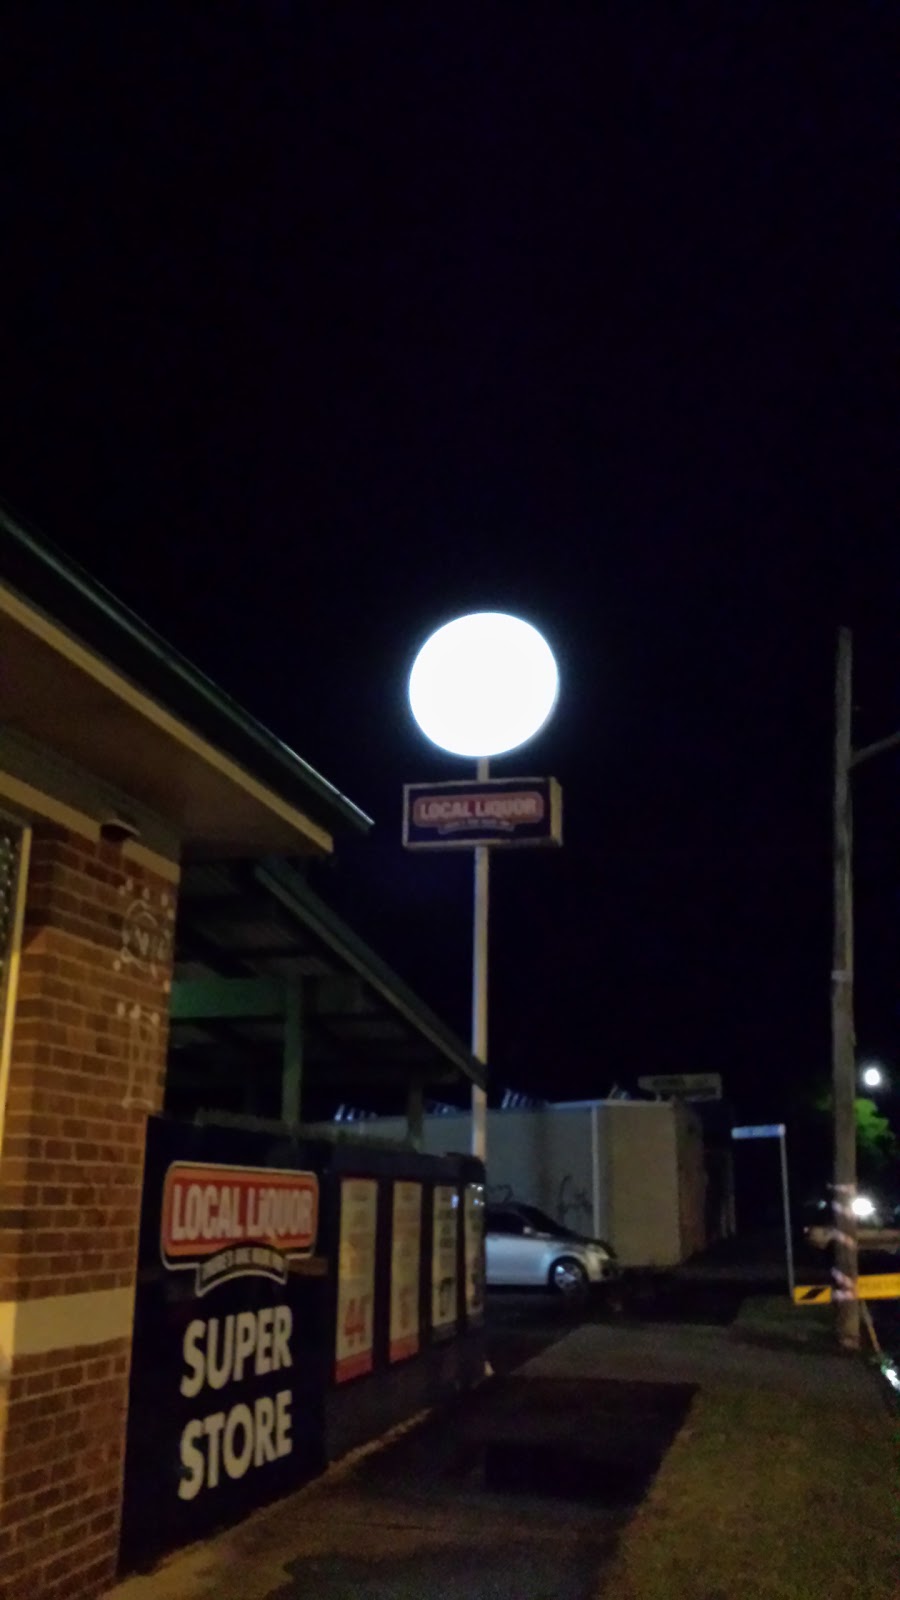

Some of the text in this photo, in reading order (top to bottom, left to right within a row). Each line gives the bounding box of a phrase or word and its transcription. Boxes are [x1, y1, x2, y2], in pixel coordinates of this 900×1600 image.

[419, 801, 472, 821] LOCAL
[171, 1183, 244, 1241] LOCAL
[180, 1305, 293, 1398] SUPER
[178, 1389, 293, 1500] STORE
